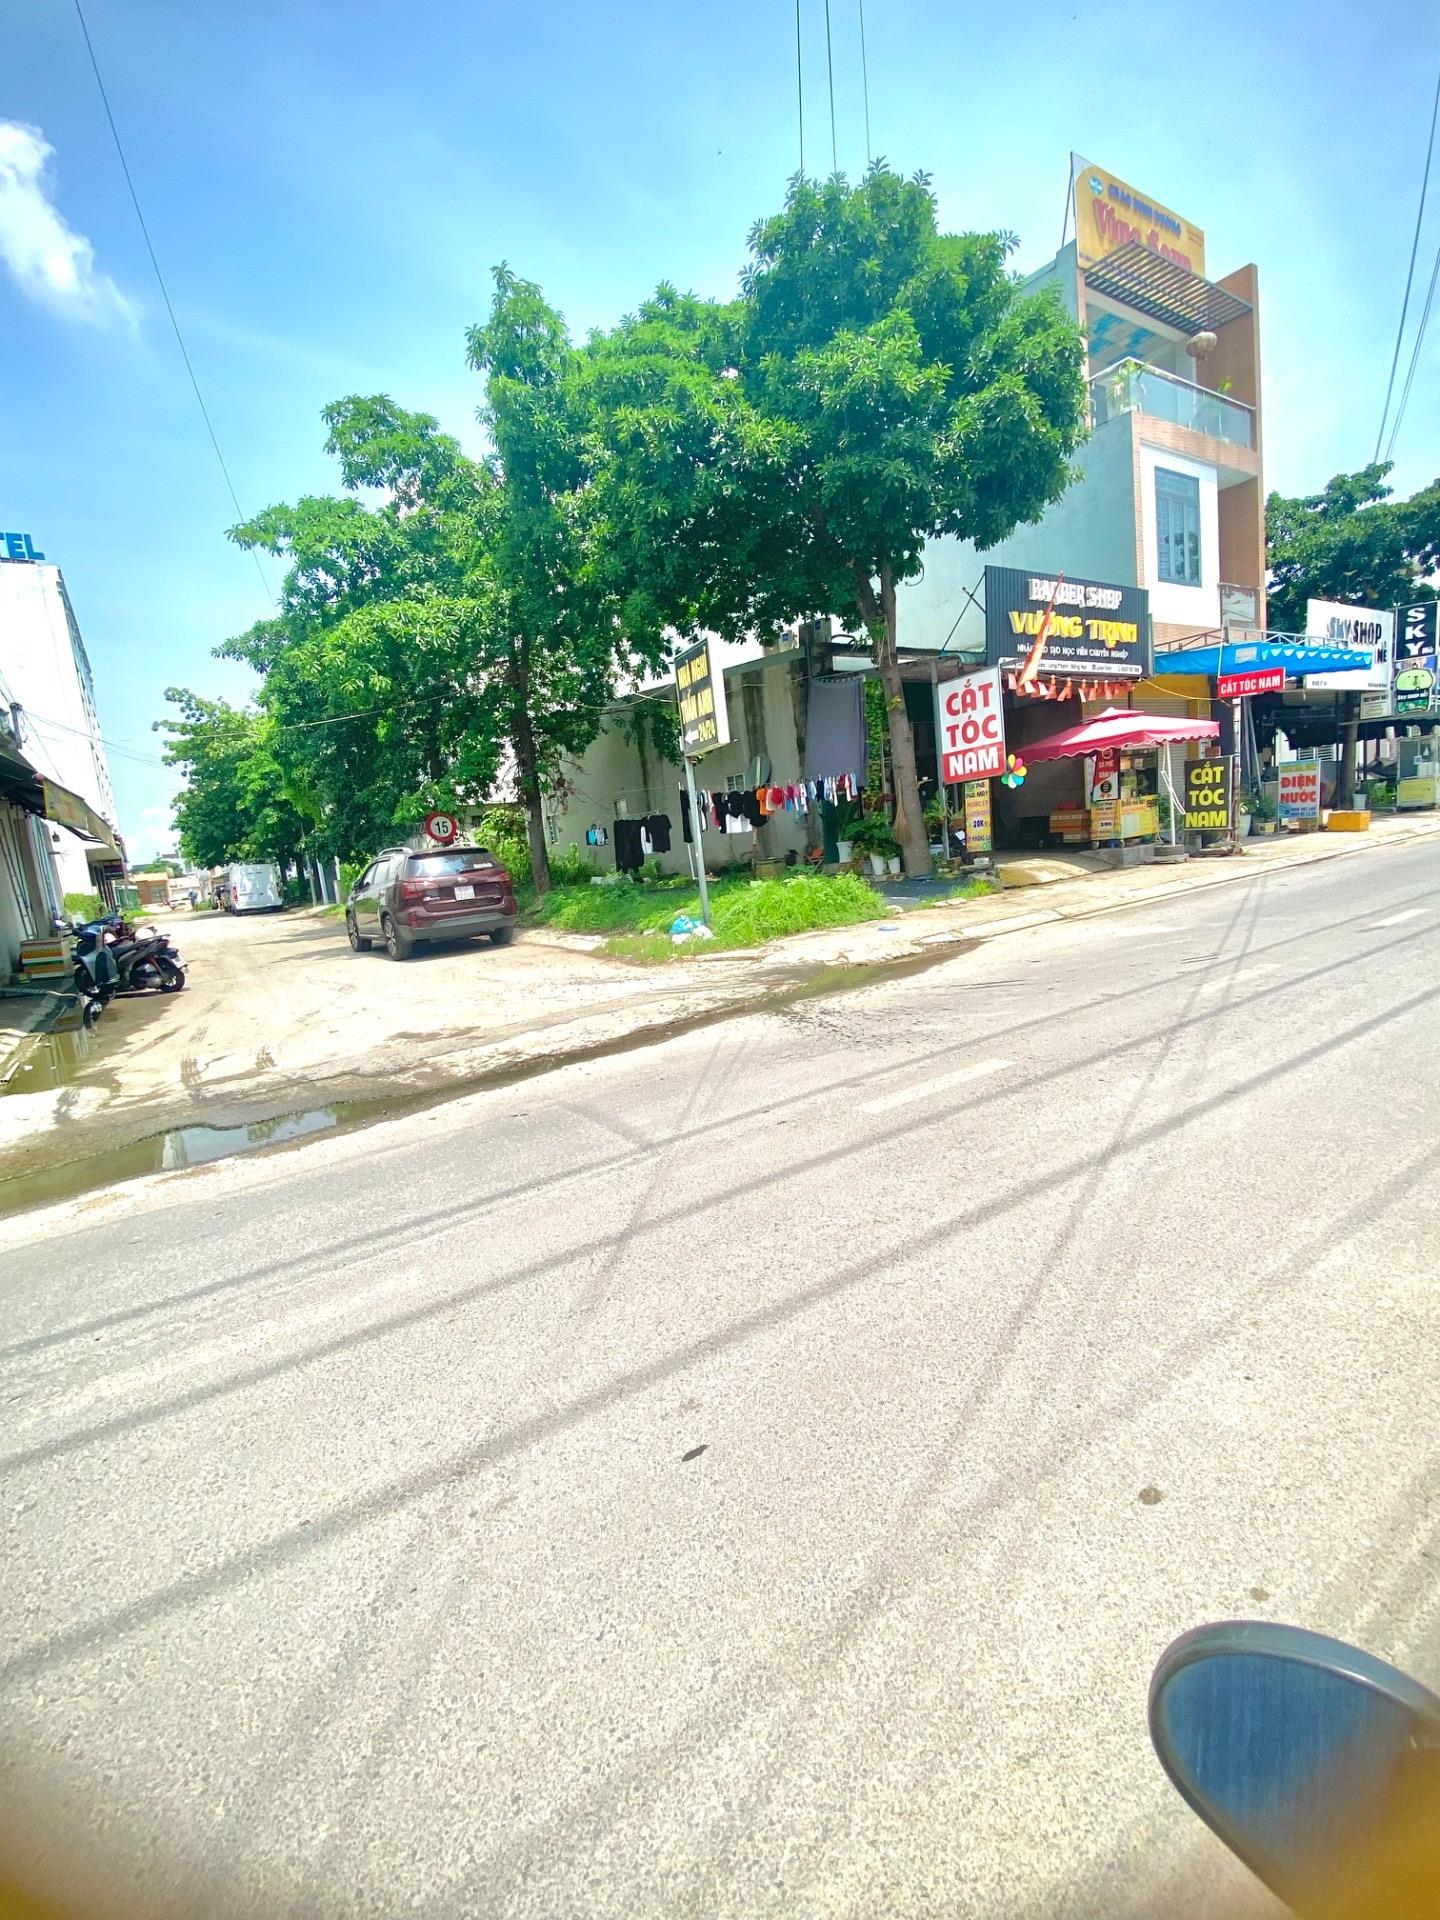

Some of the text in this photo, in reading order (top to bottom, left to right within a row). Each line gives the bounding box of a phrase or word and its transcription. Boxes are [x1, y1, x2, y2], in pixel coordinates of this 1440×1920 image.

[1028, 578, 1122, 610] BARBER SHOP
[1327, 616, 1382, 646] SKY SHOP
[1405, 607, 1427, 656] SKY
[1220, 675, 1281, 695] CẮT TÓC NAM
[945, 678, 993, 717] CẮT
[946, 714, 998, 748] TÓC
[949, 746, 999, 777] NAM
[1190, 762, 1225, 785] CẮT
[1280, 773, 1317, 790] ĐIỆN
[1190, 786, 1225, 807] TÓC
[1280, 789, 1317, 804] NƯỚC
[435, 821, 449, 834] 15
[1186, 811, 1227, 828] NAM
